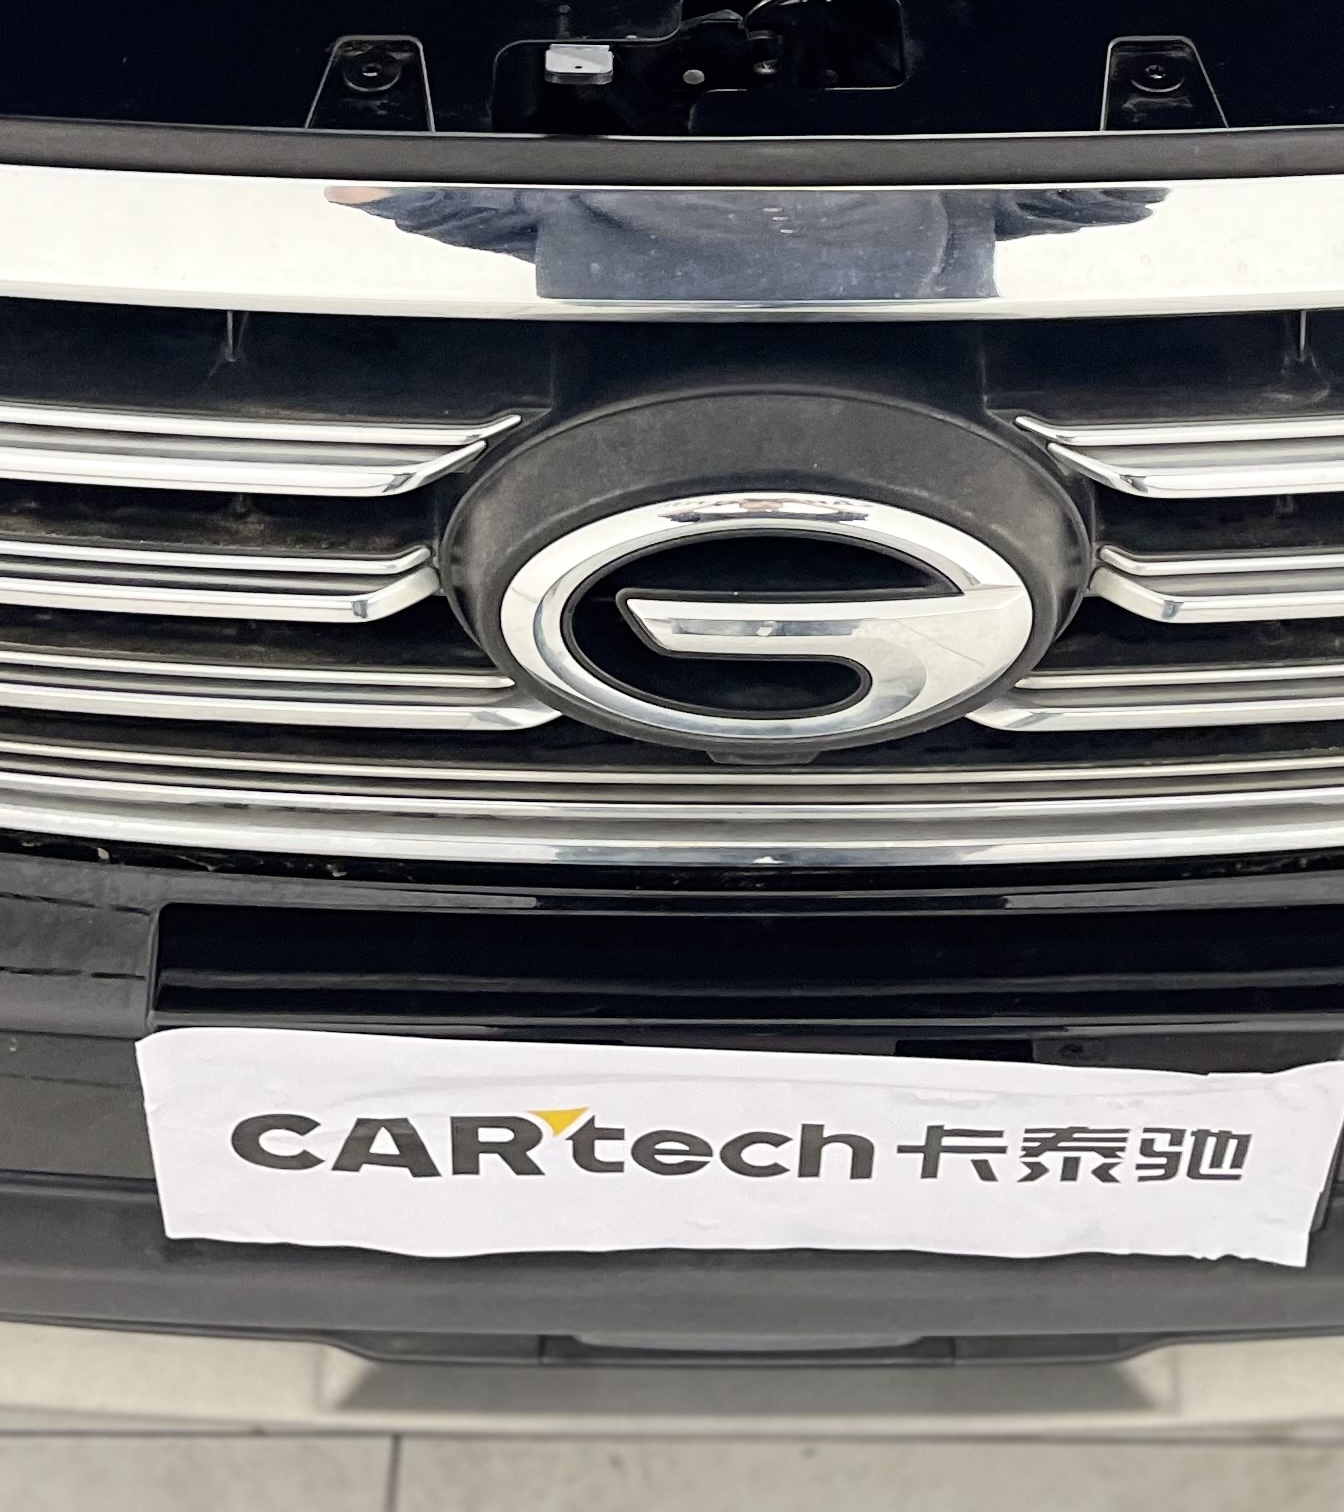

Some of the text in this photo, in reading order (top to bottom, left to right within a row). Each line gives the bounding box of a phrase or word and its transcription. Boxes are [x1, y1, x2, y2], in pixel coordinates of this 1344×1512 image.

[230, 1108, 1253, 1183] CARtech 卡泰驰
